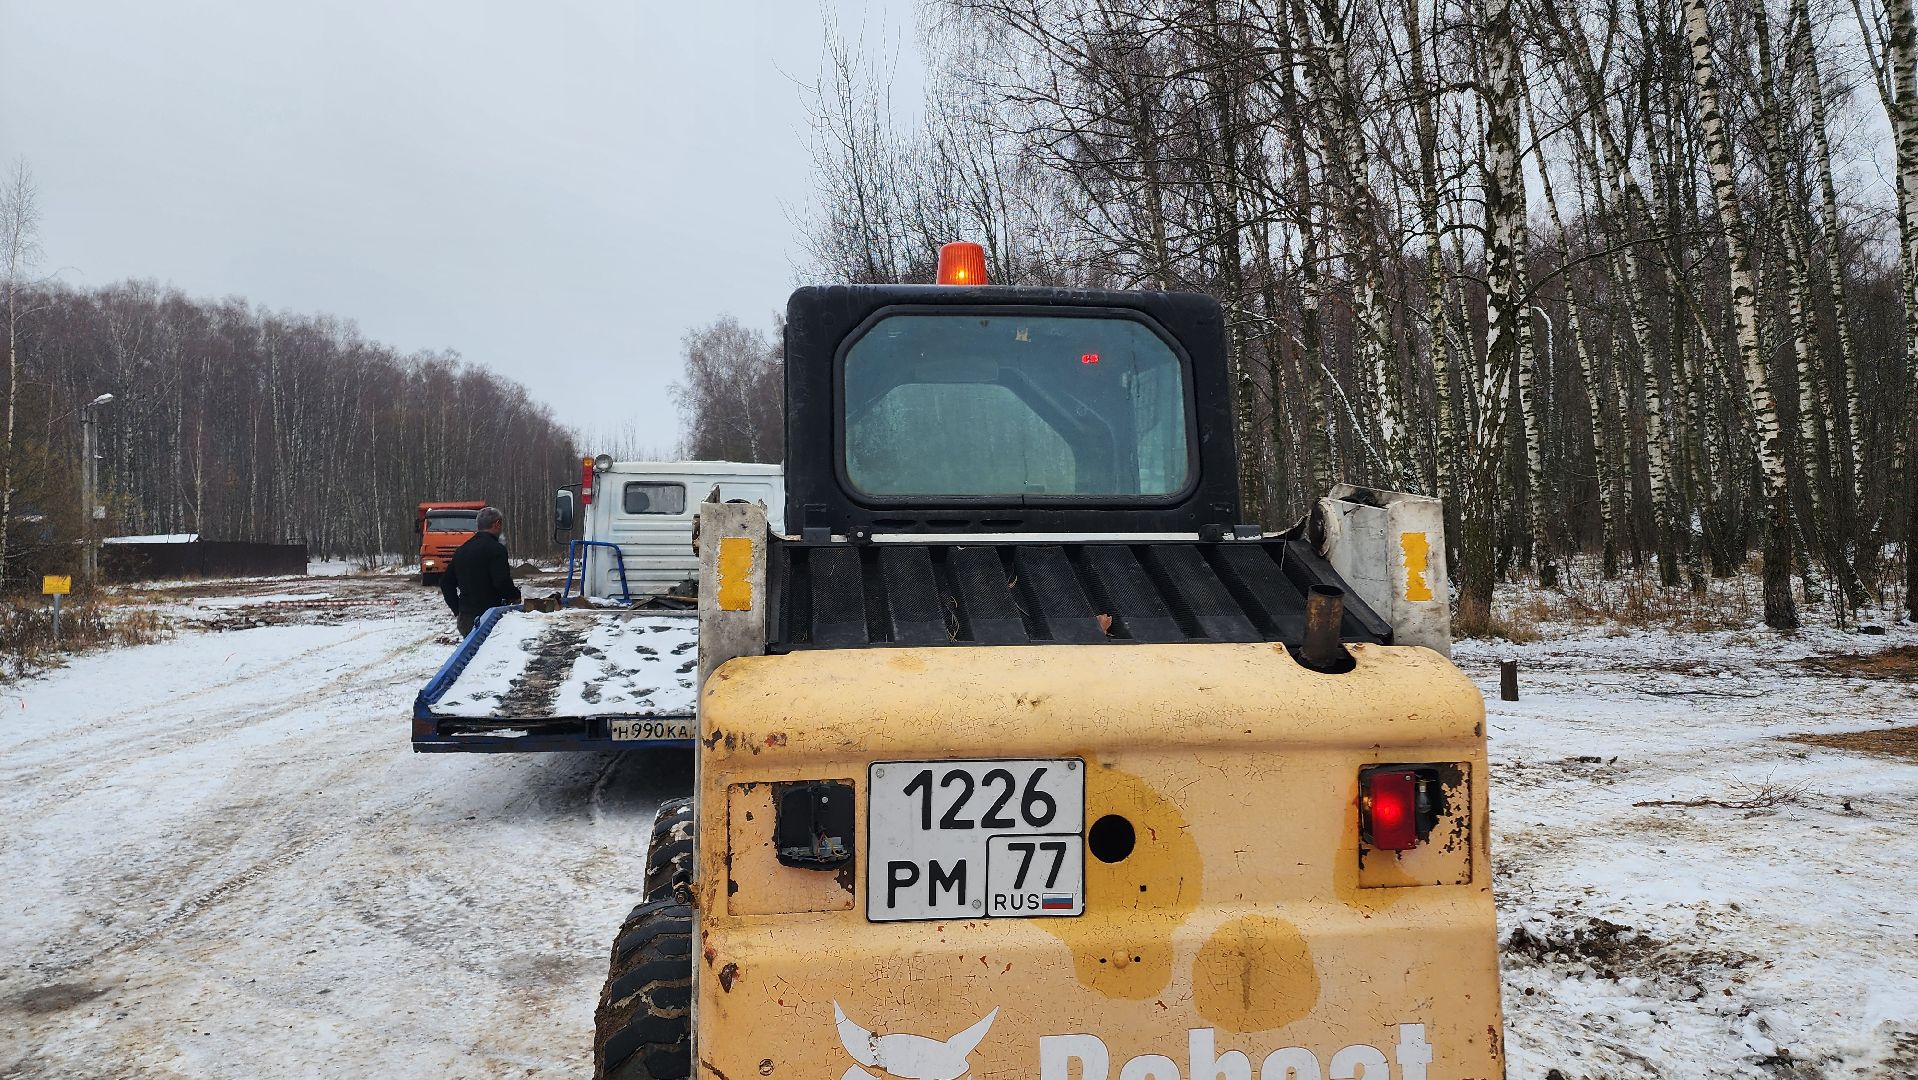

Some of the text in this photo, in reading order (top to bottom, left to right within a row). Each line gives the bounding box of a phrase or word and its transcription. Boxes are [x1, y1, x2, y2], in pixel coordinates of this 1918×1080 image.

[903, 768, 1057, 830] 1226
[887, 859, 967, 908] РМ
[1007, 842, 1067, 889] 77
[994, 894, 1040, 910] RUS
